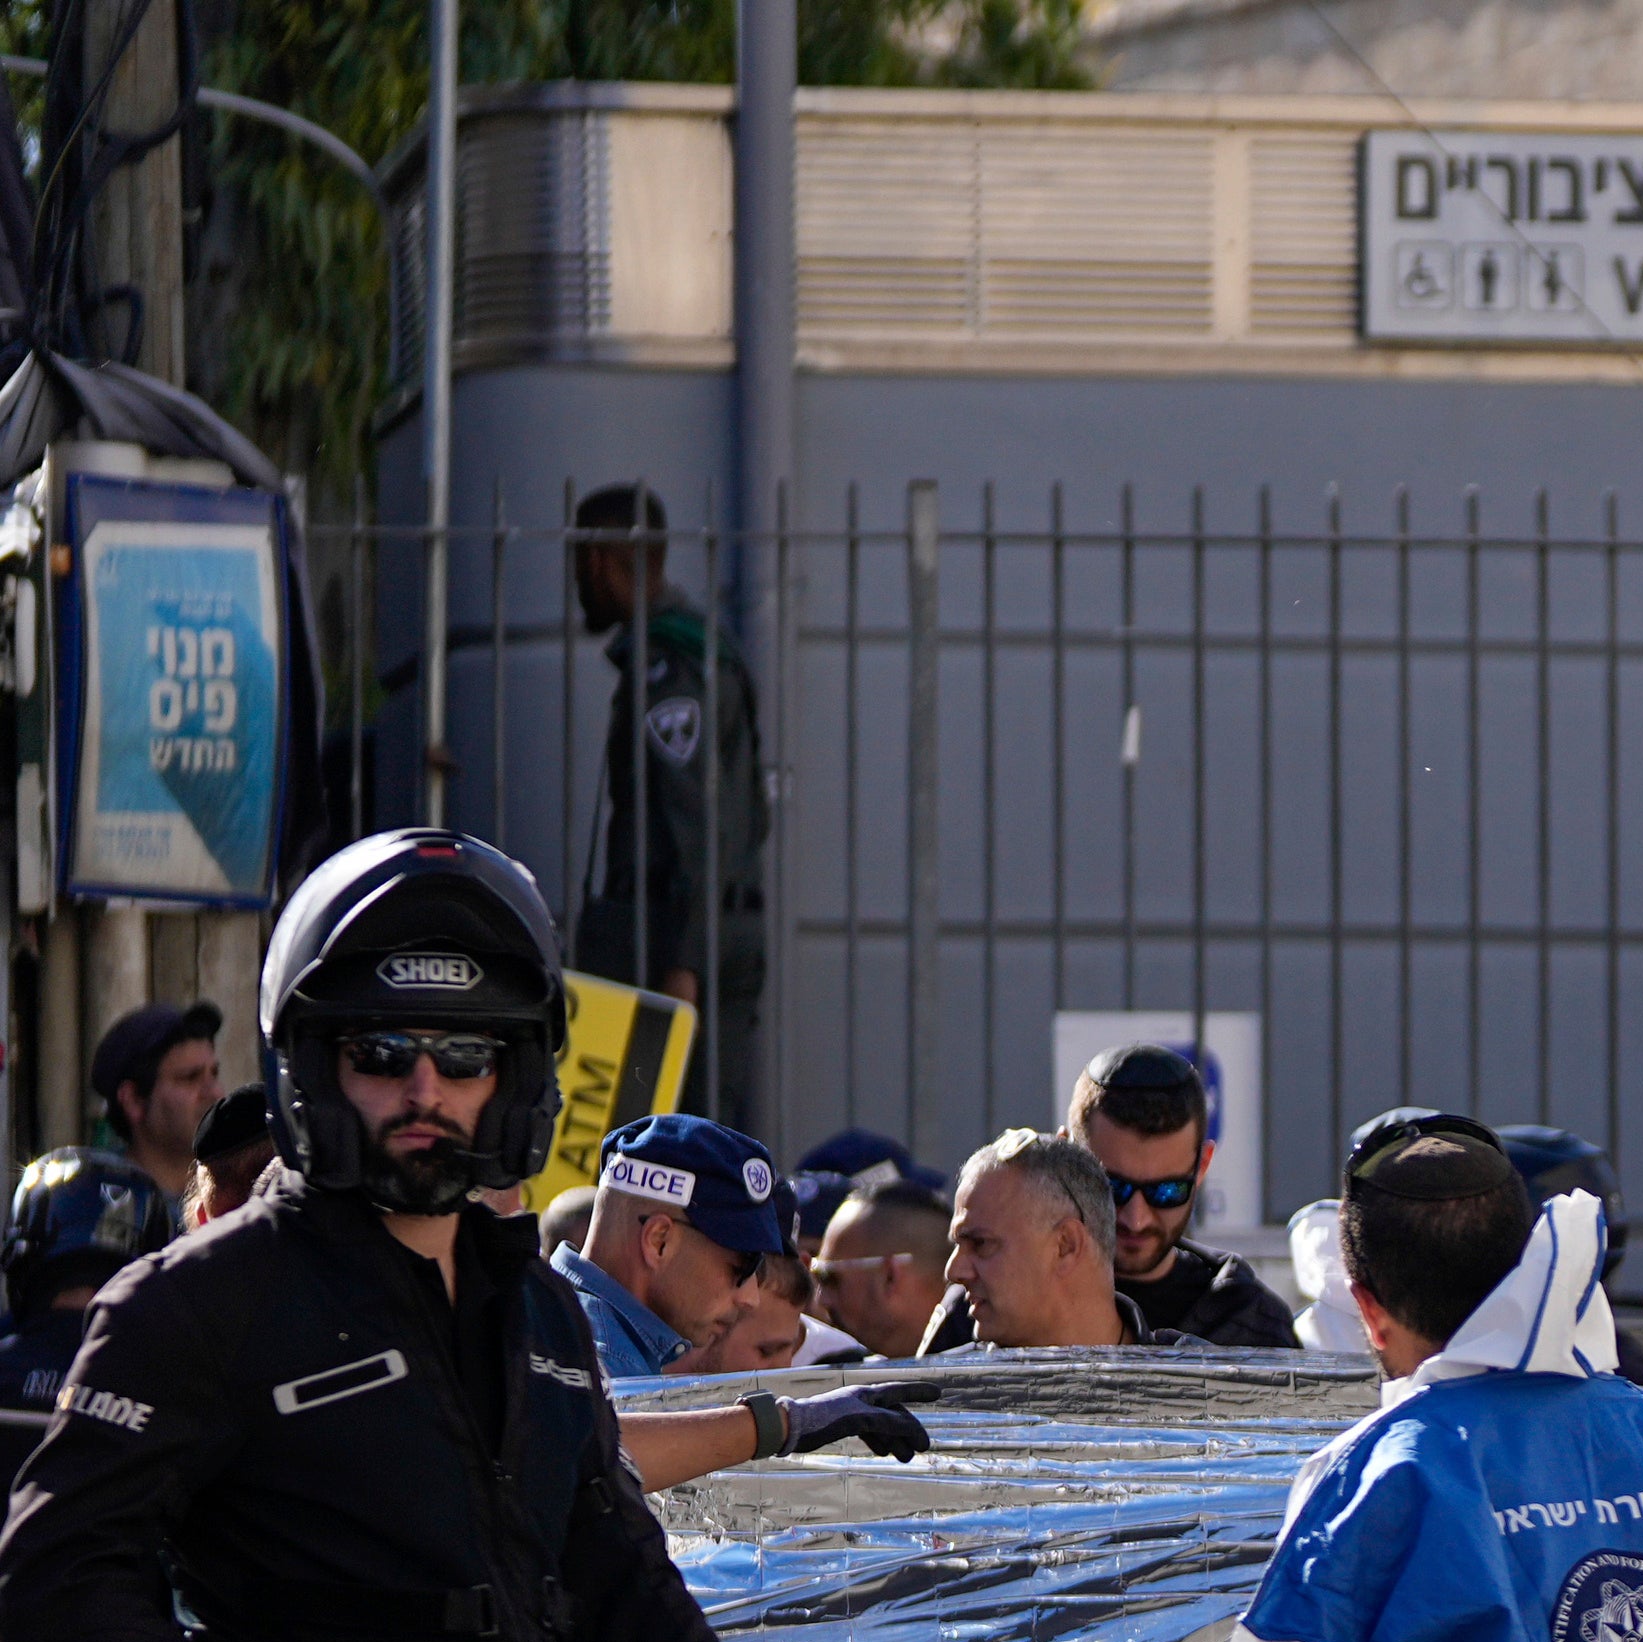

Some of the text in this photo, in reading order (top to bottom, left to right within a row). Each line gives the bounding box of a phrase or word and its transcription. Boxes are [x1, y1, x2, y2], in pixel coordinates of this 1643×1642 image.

[147, 626, 235, 679] מנוי
[150, 678, 237, 734] פיס
[150, 737, 236, 772] החדש
[391, 958, 469, 982] SHOEI
[557, 1053, 617, 1177] ATM
[1597, 1554, 1620, 1566] AND
